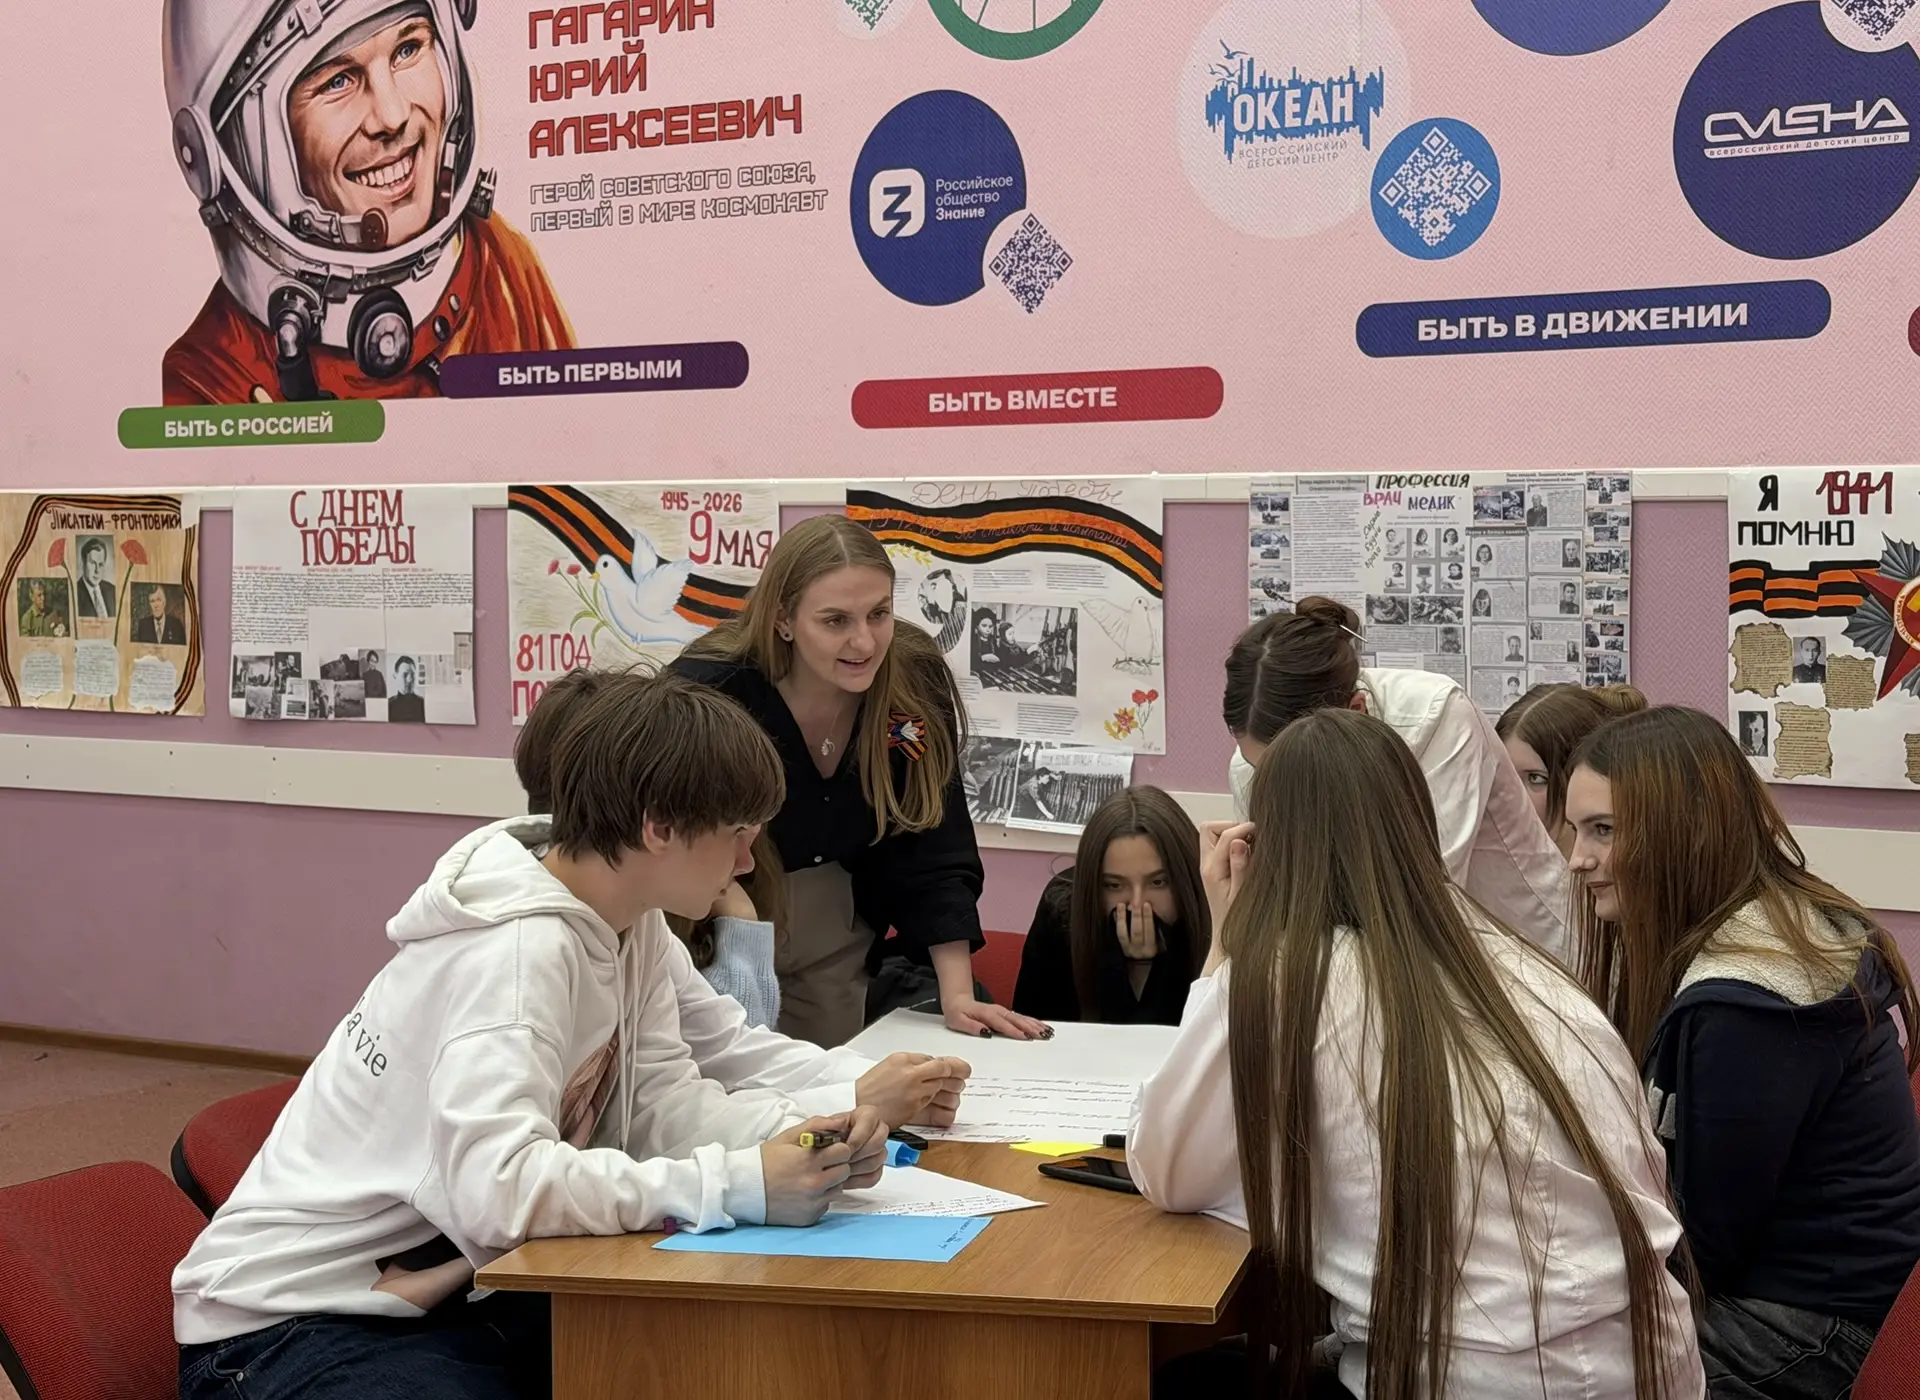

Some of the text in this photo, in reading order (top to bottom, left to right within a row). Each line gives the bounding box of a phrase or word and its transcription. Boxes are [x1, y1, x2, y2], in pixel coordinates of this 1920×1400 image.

[529, 0, 714, 49] ГАГАРИН
[529, 39, 647, 103] ЮРИЙ
[529, 94, 802, 158] АЛЕКСЕЕВИЧ
[1233, 83, 1354, 132] ОКЕАН
[1704, 97, 1909, 143] СМЕНА
[1239, 139, 1348, 158] ВСЕРОССИЙСКИЙ
[1248, 152, 1340, 169] ДЕТСКИЙ ЦЕНТР
[1709, 141, 1799, 156] всероссийский
[1864, 134, 1901, 146] центр
[530, 161, 816, 204] ГЕРОЙ СОВЕТСКОГО СОЮЗА,
[935, 175, 1013, 192] Российское
[935, 191, 1000, 207] общество
[531, 189, 828, 232] ПЕРВЫЙ В МИРЕ КОСМОНАВТ
[935, 206, 986, 221] Знание
[1418, 303, 1748, 341] БЫТЬ В ДВИЖЕНИИ
[498, 360, 683, 385] БЫТЬ ПЕРВЫМИ
[929, 387, 1118, 413] БЫТЬ ВМЕСТЕ
[164, 411, 333, 438] БЫТЬ С РОССИЕЙ
[289, 489, 404, 528] С ДНЕМ
[1363, 490, 1402, 506] ВРАЧ
[1757, 474, 1779, 512] Я
[1815, 471, 1894, 514] 1941
[300, 526, 416, 566] ПОБЕДЫ
[689, 510, 774, 570] 9 МАЯ
[1737, 519, 1855, 546] ПОМНЮ
[516, 632, 591, 672] 81 ГОД
[355, 1028, 387, 1077] vie
